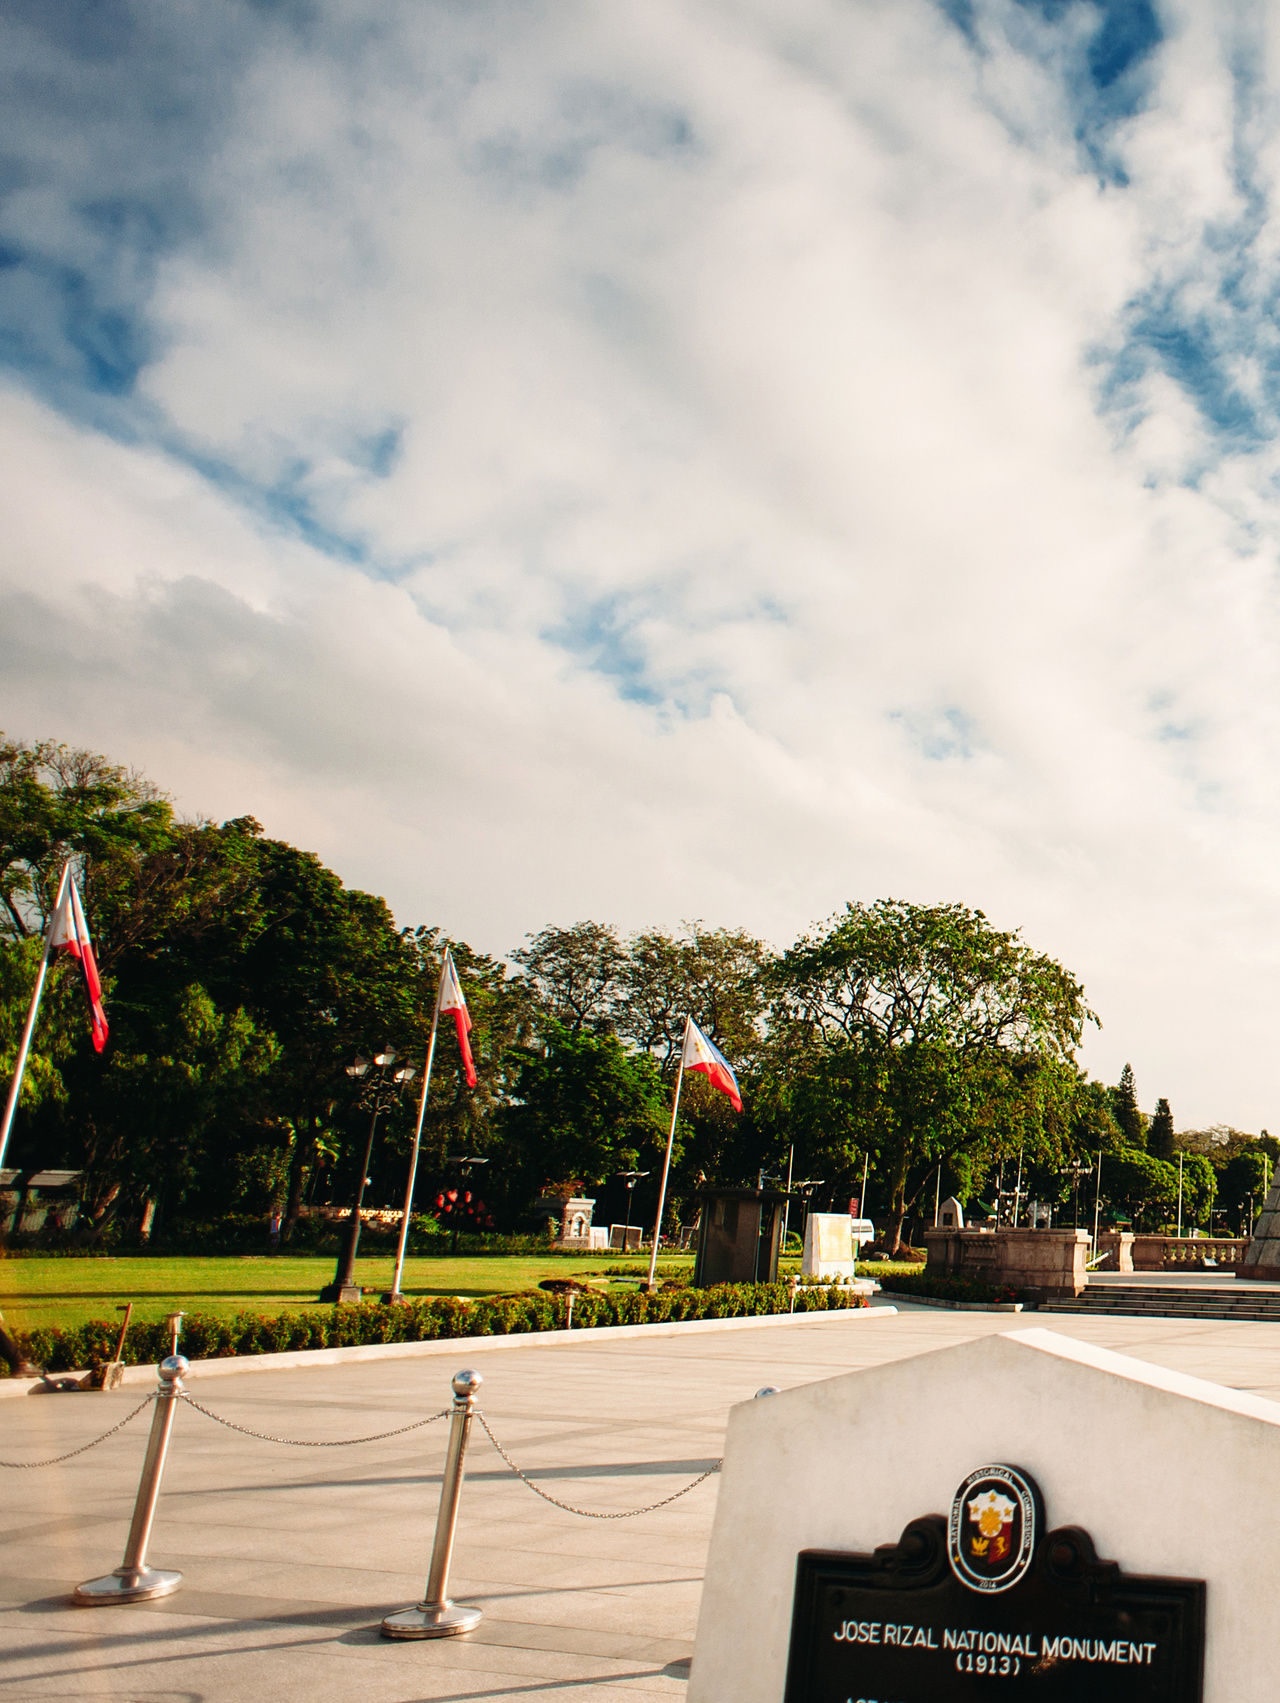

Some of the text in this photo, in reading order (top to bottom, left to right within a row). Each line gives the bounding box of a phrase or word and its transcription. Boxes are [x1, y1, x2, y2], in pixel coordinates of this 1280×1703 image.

[951, 1468, 1033, 1548] NATIONAL HISTORICAL COMMISSION
[833, 1620, 1157, 1665] JOSE RIZAL NATIONAL MONUMENT
[956, 1654, 1020, 1676] (1913)
